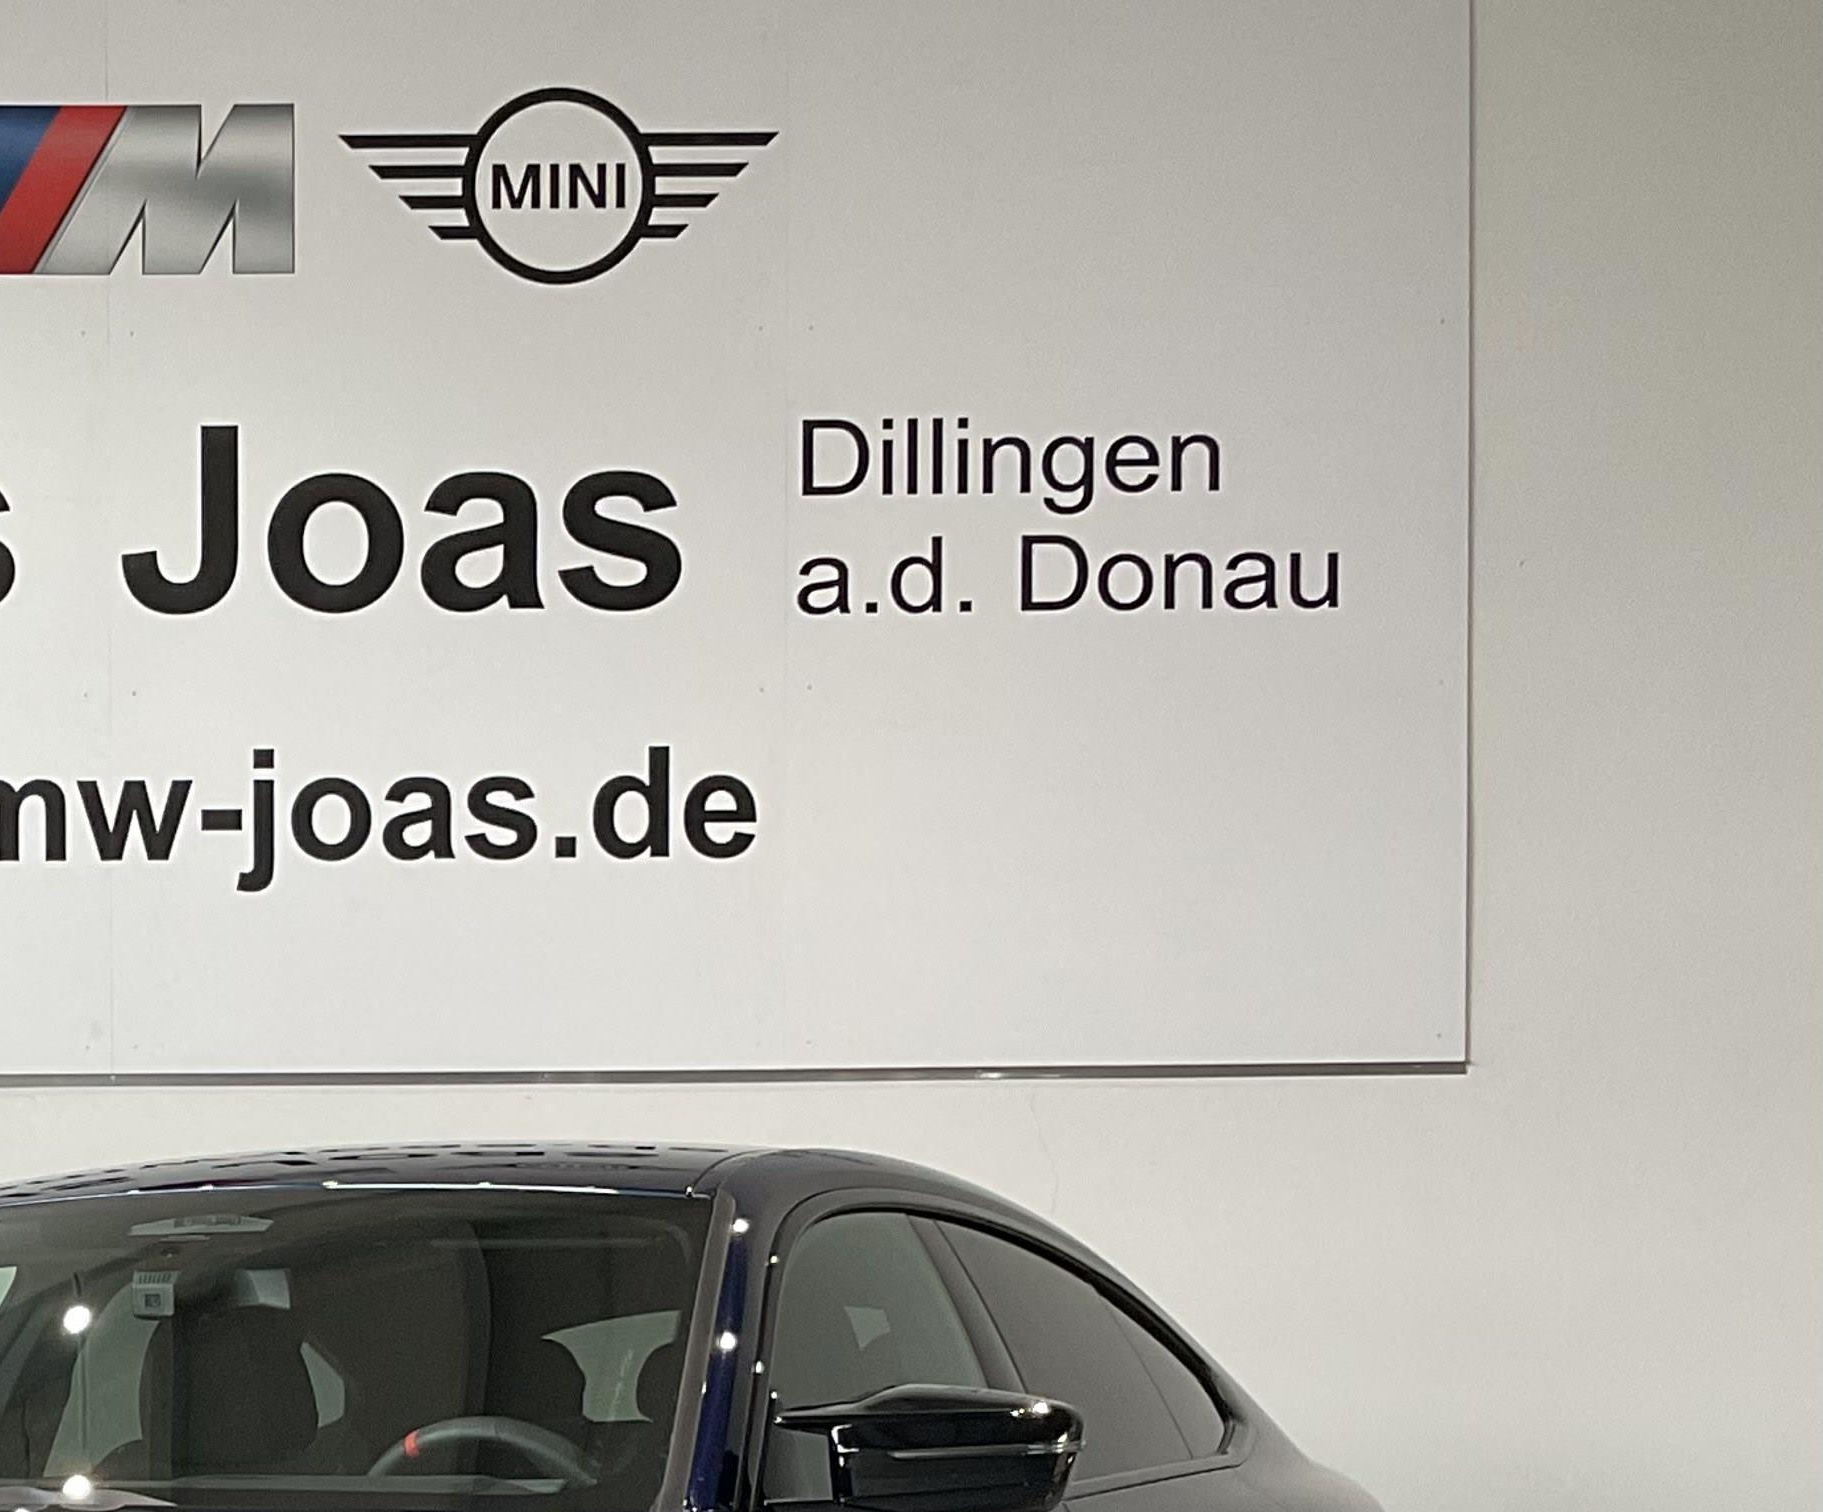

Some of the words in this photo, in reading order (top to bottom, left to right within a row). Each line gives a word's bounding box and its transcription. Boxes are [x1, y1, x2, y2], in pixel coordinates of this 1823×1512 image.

[492, 163, 626, 209] MINI
[802, 417, 1220, 515] Dillingen
[122, 425, 682, 615] Joas
[797, 535, 972, 615] a.d.
[1021, 534, 1339, 612] Donau
